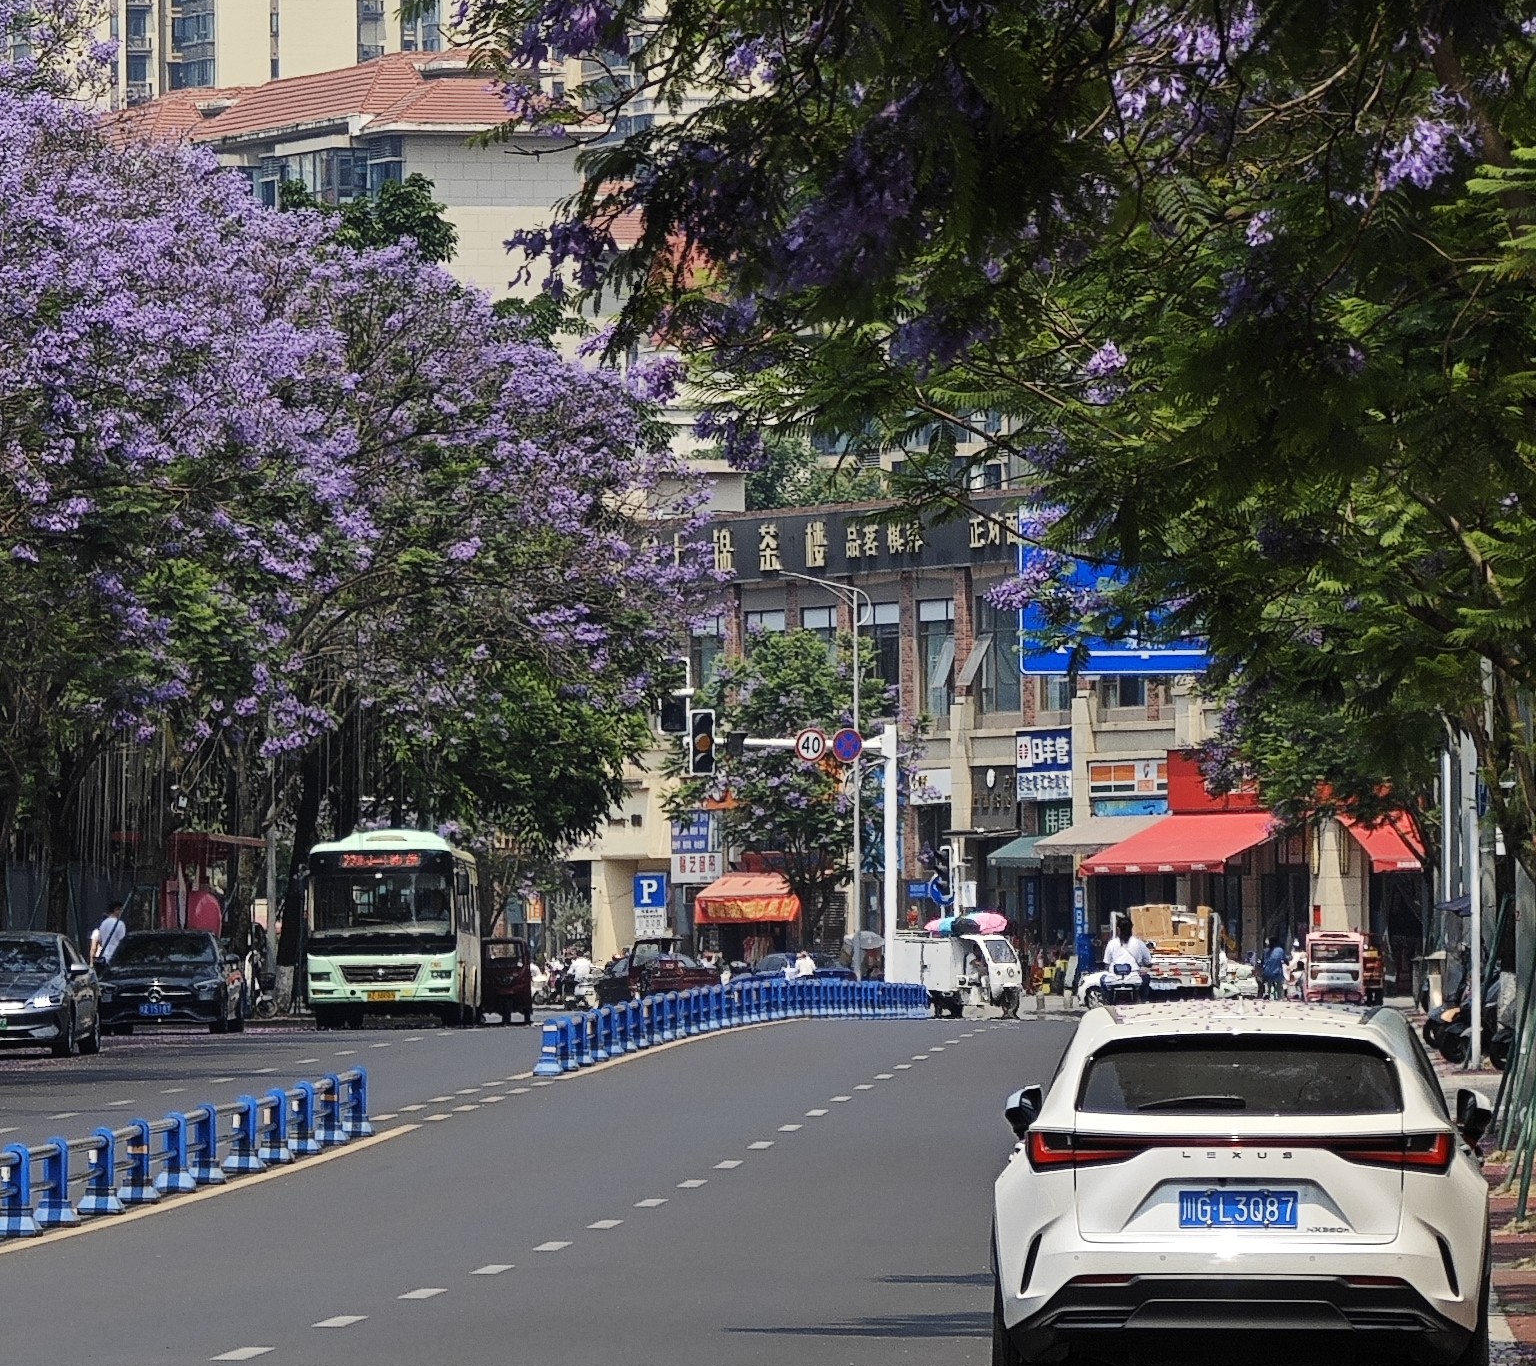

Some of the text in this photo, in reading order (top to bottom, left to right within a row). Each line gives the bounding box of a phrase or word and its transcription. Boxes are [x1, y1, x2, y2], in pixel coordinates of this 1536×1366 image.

[801, 736, 820, 755] 40
[1032, 736, 1070, 764] 日丰管
[639, 879, 658, 904] P
[1182, 1151, 1293, 1159] LEXUS
